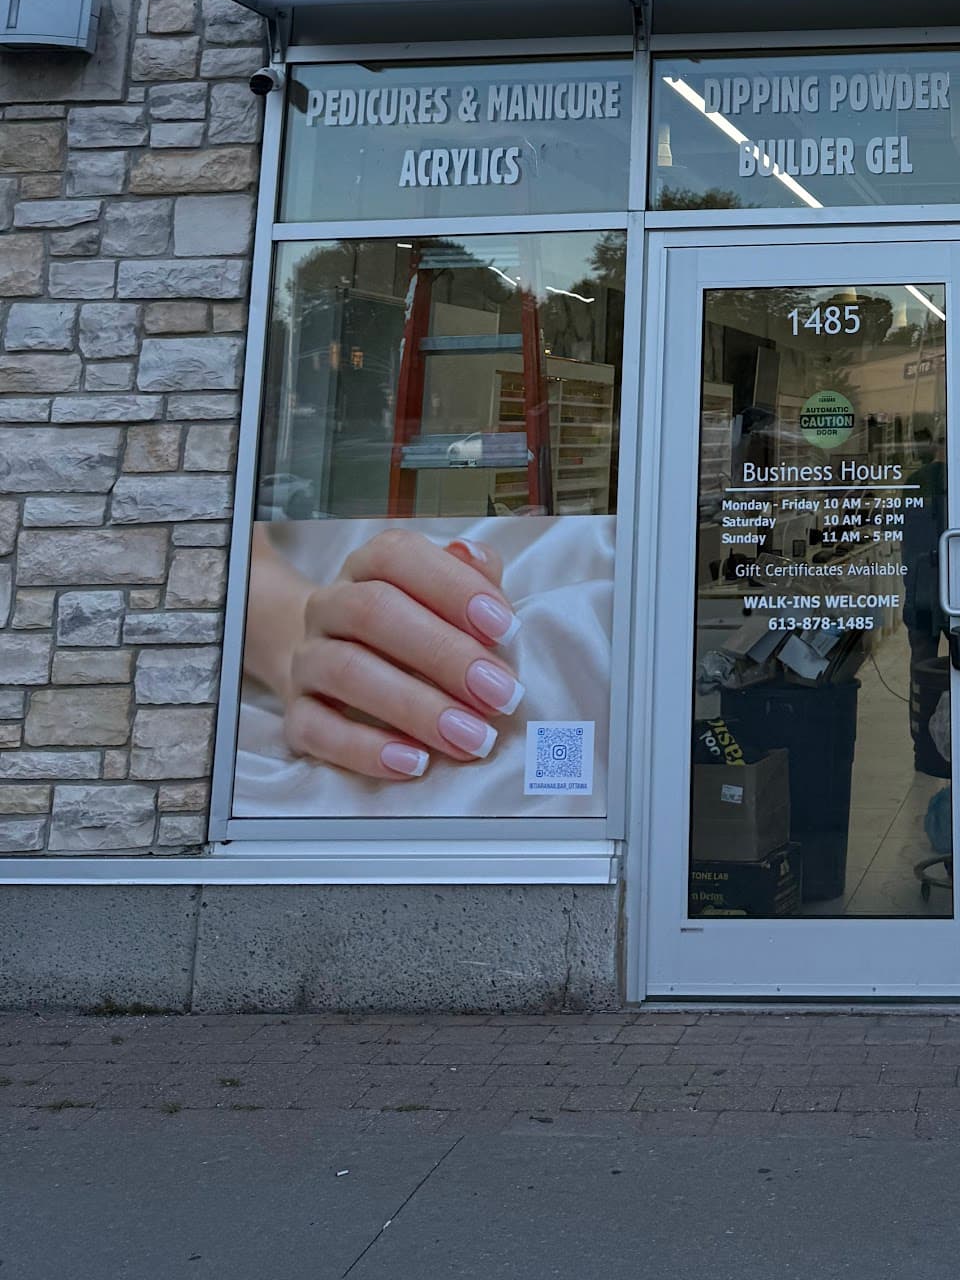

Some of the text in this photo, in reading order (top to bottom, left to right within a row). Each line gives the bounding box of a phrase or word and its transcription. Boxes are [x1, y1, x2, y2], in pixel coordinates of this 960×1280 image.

[704, 71, 950, 115] DIPPING POWDER
[305, 80, 621, 126] PEDICURES & MANICURE
[738, 135, 913, 177] BUILDER GEL
[399, 147, 521, 187] ACRYLICS
[787, 305, 860, 336] 1485
[805, 406, 849, 414] AUTOMATIC
[801, 415, 853, 427] CAUTION
[743, 461, 902, 482] Business Hours
[722, 500, 770, 513] Monday
[782, 499, 820, 512] Friday
[823, 499, 839, 509] 10
[842, 498, 861, 509] AM
[874, 498, 902, 509] 7:30
[905, 497, 924, 508] PM
[722, 516, 776, 530] Saturday
[823, 515, 839, 526] 10
[842, 515, 862, 526] AM
[874, 514, 882, 525] 6
[886, 514, 904, 525] PM
[722, 533, 767, 547] Sunday
[822, 532, 838, 543] 11
[841, 531, 860, 542] AM
[873, 531, 880, 542] 5
[884, 531, 903, 542] PM
[735, 562, 908, 577] Gift Certificates Available
[744, 594, 900, 609] WALK-INS WELCOME
[768, 617, 874, 631] 613-878-1485
